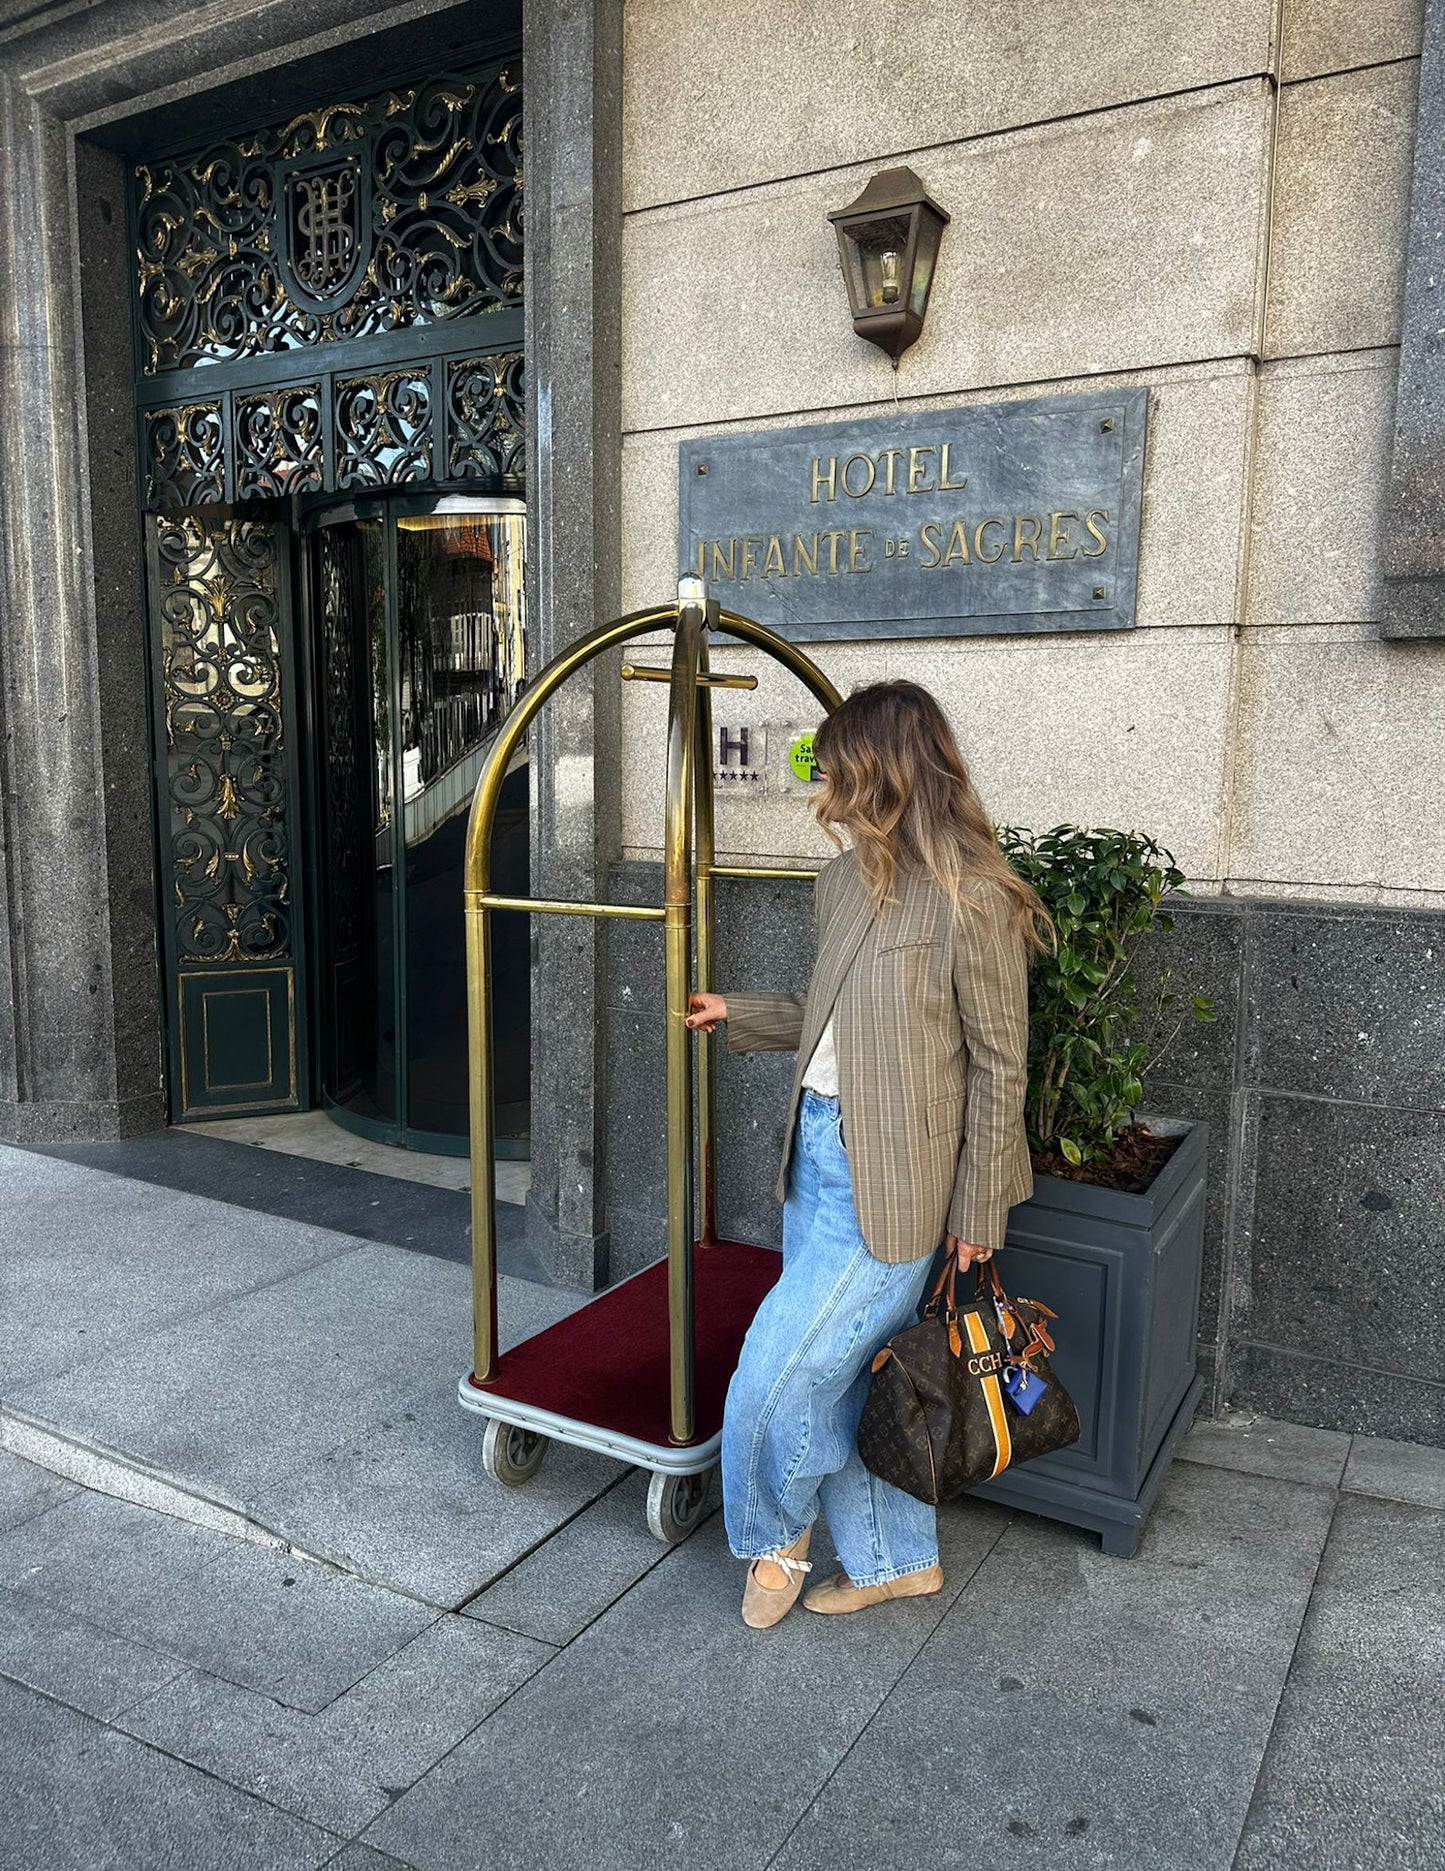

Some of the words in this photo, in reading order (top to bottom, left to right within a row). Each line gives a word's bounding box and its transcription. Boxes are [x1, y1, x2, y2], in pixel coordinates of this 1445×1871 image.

[809, 442, 968, 503] HOTEL
[697, 528, 876, 583] INFANTE
[884, 539, 909, 559] DE
[919, 508, 1111, 569] SAGRES
[720, 727, 748, 765] H
[795, 754, 816, 763] trav
[800, 744, 812, 753] Sa
[968, 1352, 1003, 1375] CCH
